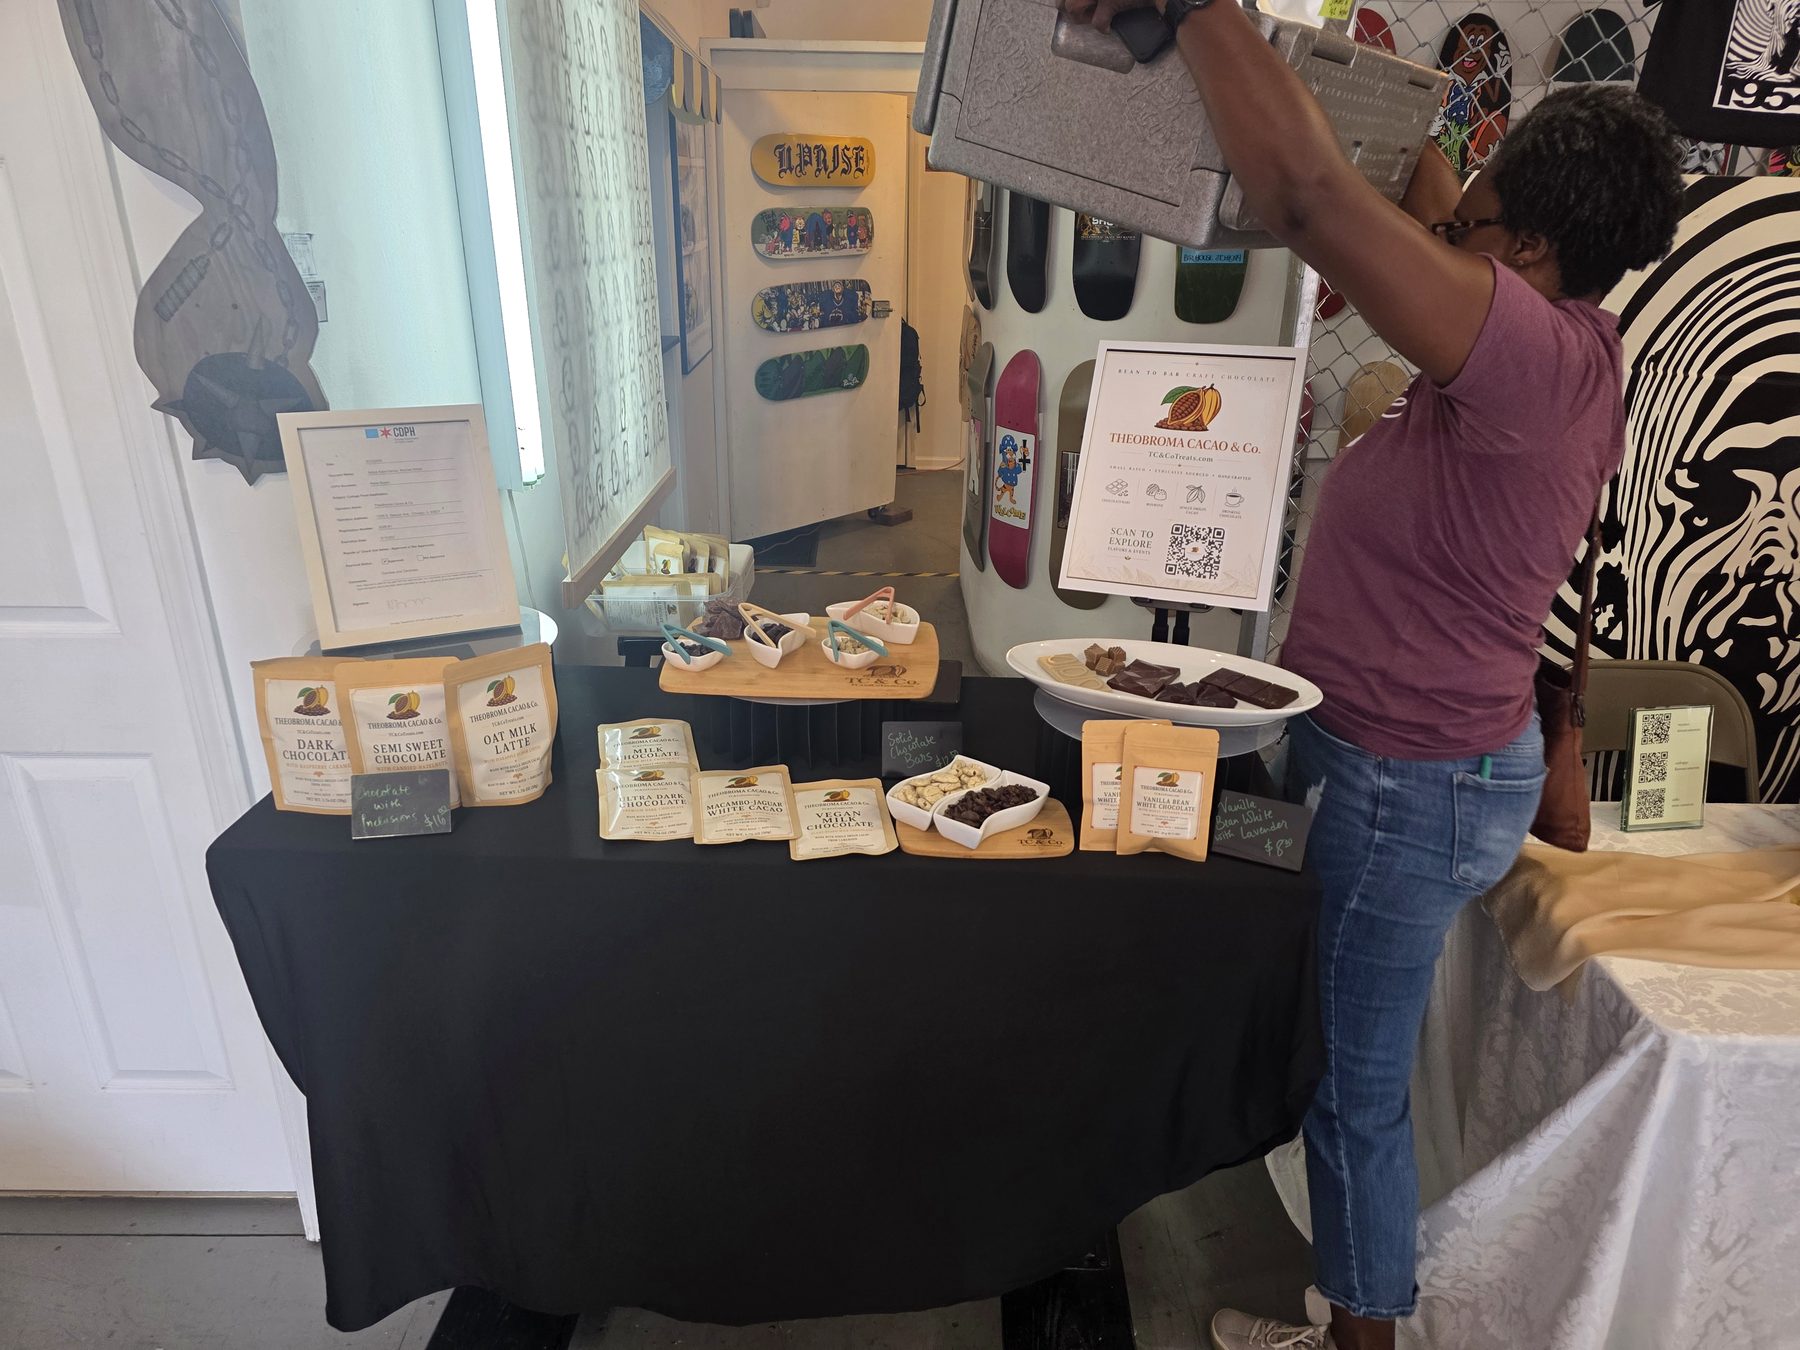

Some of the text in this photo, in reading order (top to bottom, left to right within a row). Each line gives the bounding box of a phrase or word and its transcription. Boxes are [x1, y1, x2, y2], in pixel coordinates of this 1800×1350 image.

[774, 143, 865, 179] UPRISE
[1220, 374, 1276, 382] CHOCOLATE
[1110, 432, 1261, 454] THEOBROMA CACAO & Co.
[1111, 527, 1154, 538] SCAN TO
[1109, 537, 1152, 549] EXPLORE
[469, 709, 507, 723] THEOBROMA
[508, 704, 526, 714] CACAO
[275, 717, 315, 726] THEOBROMA
[368, 721, 407, 729] THEOBROMA
[408, 719, 427, 727] CACAO
[483, 723, 536, 745] OAT MILK
[888, 730, 913, 746] Solid
[297, 739, 334, 750] DARK
[373, 739, 443, 753] SEMI SWEET
[495, 737, 530, 754] LATTE
[890, 736, 936, 759] Chocolate
[283, 750, 350, 761] CHOCOLAT
[375, 750, 446, 764] CHOCOLATE
[904, 752, 933, 768] Bars
[620, 799, 687, 808] CHOCOLATE
[706, 799, 783, 811] MACAMBO-JAGUAR
[1143, 796, 1170, 804] VANILLA
[1218, 796, 1256, 813] Vanilla
[707, 806, 745, 817] WHITE
[1158, 803, 1195, 812] CHOCOLATE
[1242, 809, 1273, 824] White
[806, 822, 874, 830] CHOCOLATE
[1241, 820, 1288, 839] Lavender
